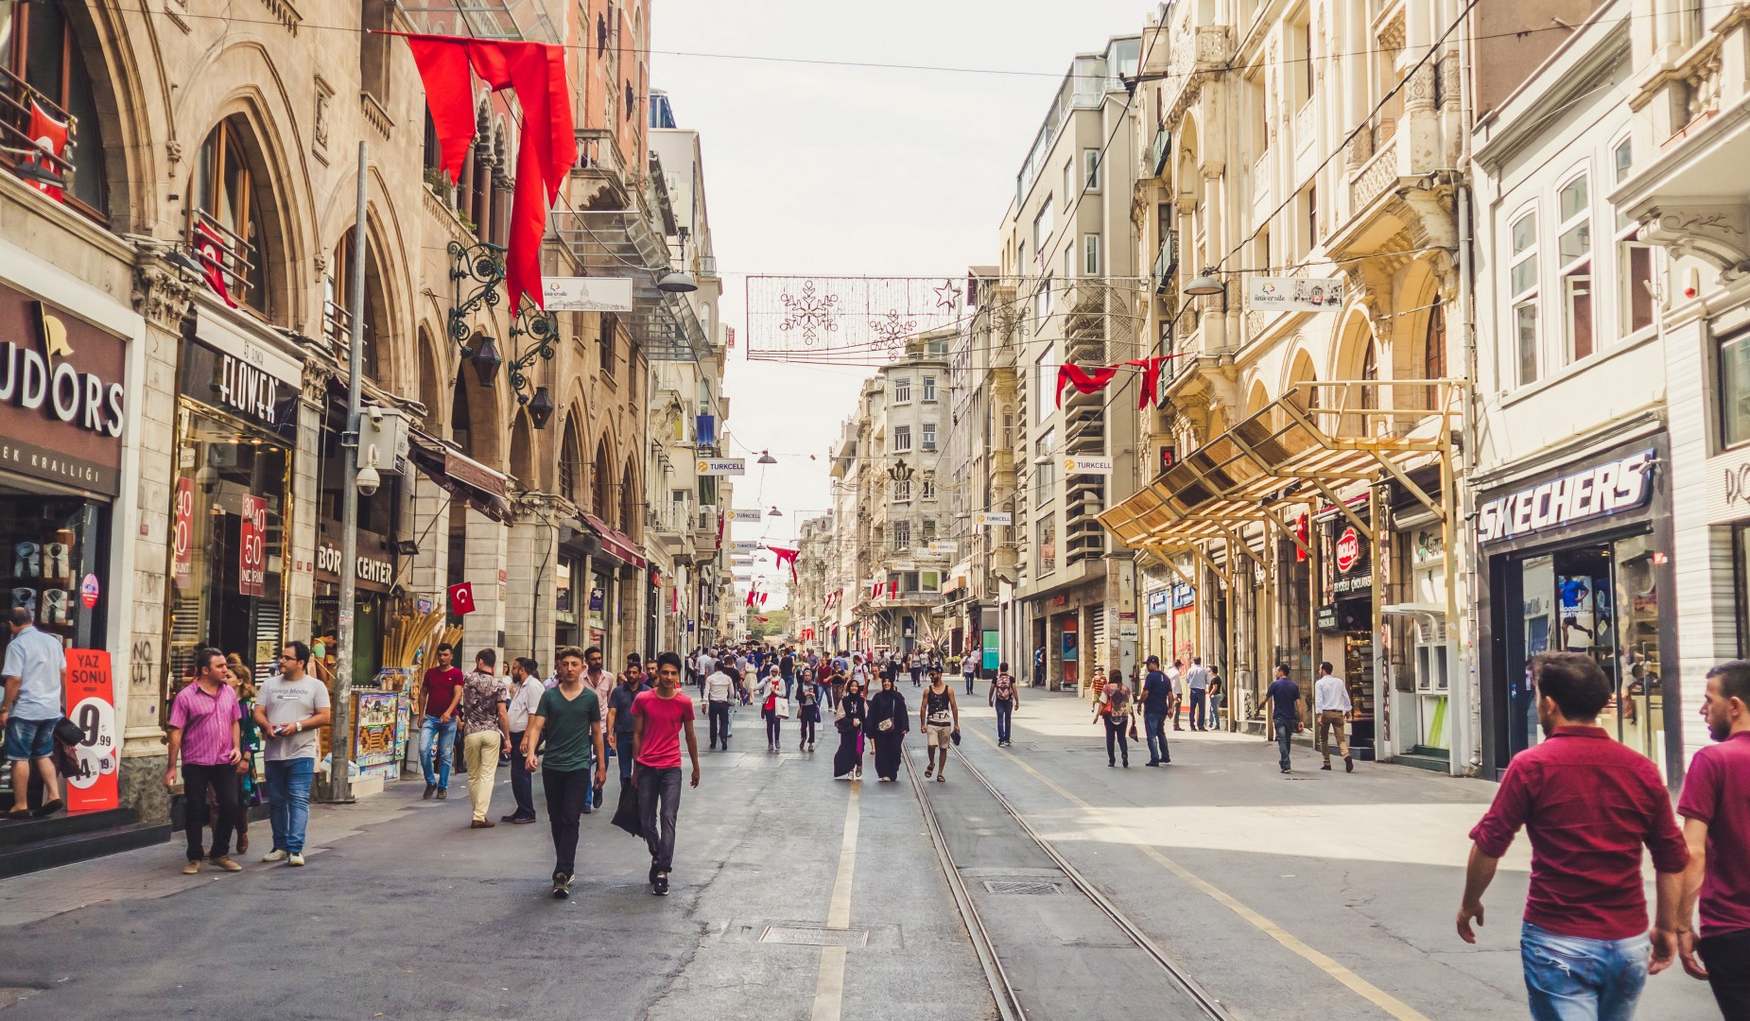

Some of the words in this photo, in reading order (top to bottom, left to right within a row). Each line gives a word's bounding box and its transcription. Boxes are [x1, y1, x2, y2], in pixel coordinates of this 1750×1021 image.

[220, 354, 276, 424] FLOWER
[31, 454, 99, 482] KRALLIĞI
[1478, 449, 1653, 543] SKECHERS
[245, 534, 261, 565] 50
[357, 556, 393, 586] CENTER
[72, 670, 106, 684] SONU
[77, 655, 99, 669] YAZ
